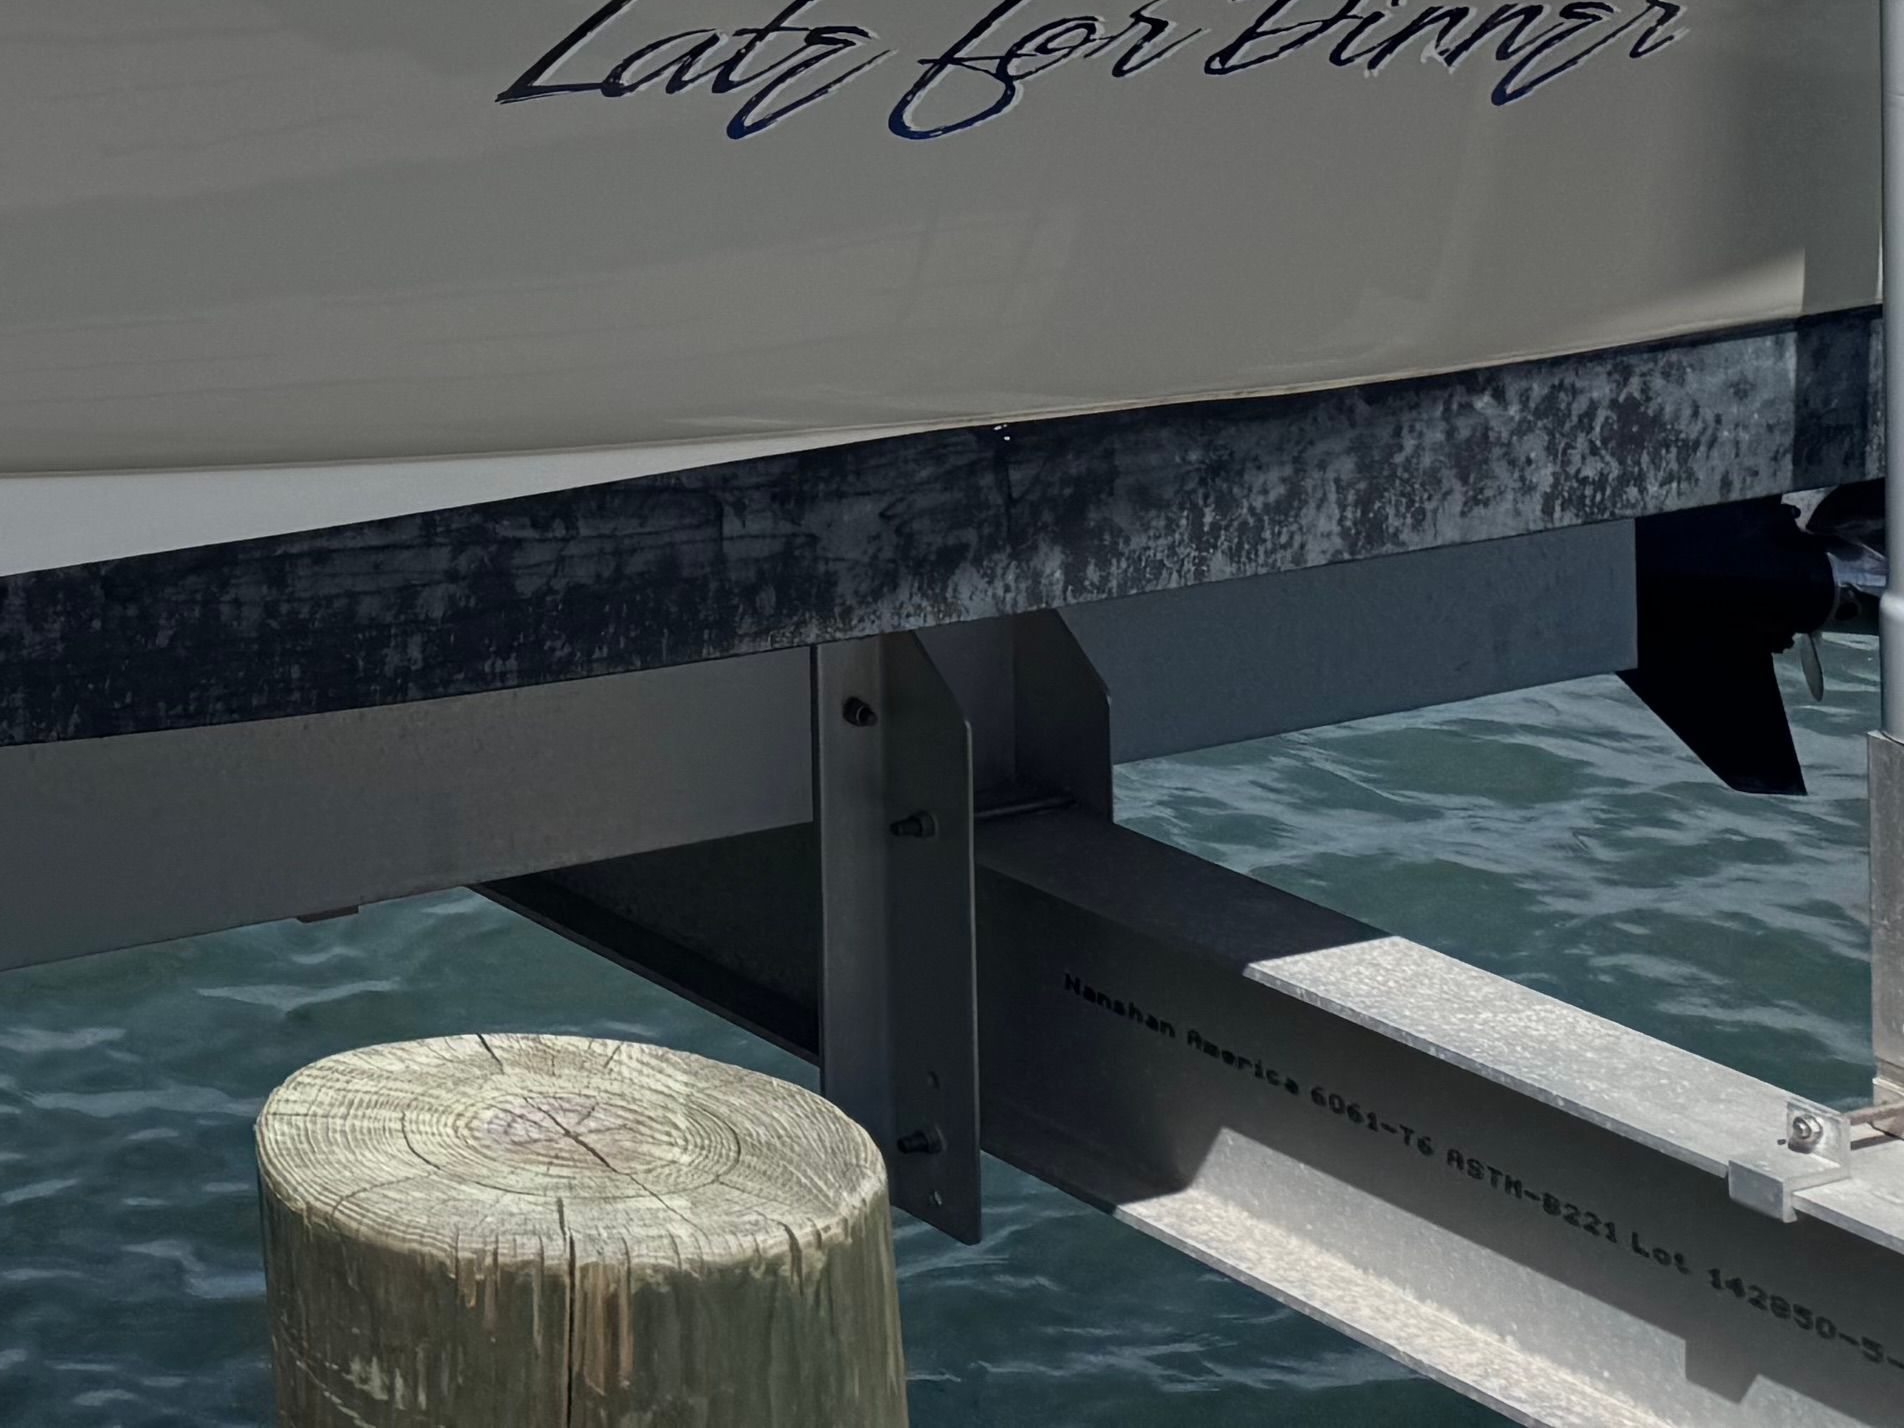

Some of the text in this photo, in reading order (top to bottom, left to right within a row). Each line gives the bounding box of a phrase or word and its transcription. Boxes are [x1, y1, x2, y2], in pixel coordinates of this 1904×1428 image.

[1063, 973, 1176, 1038] Nanshan
[1187, 1029, 1300, 1095] America
[1310, 1086, 1434, 1157] 6061-T6
